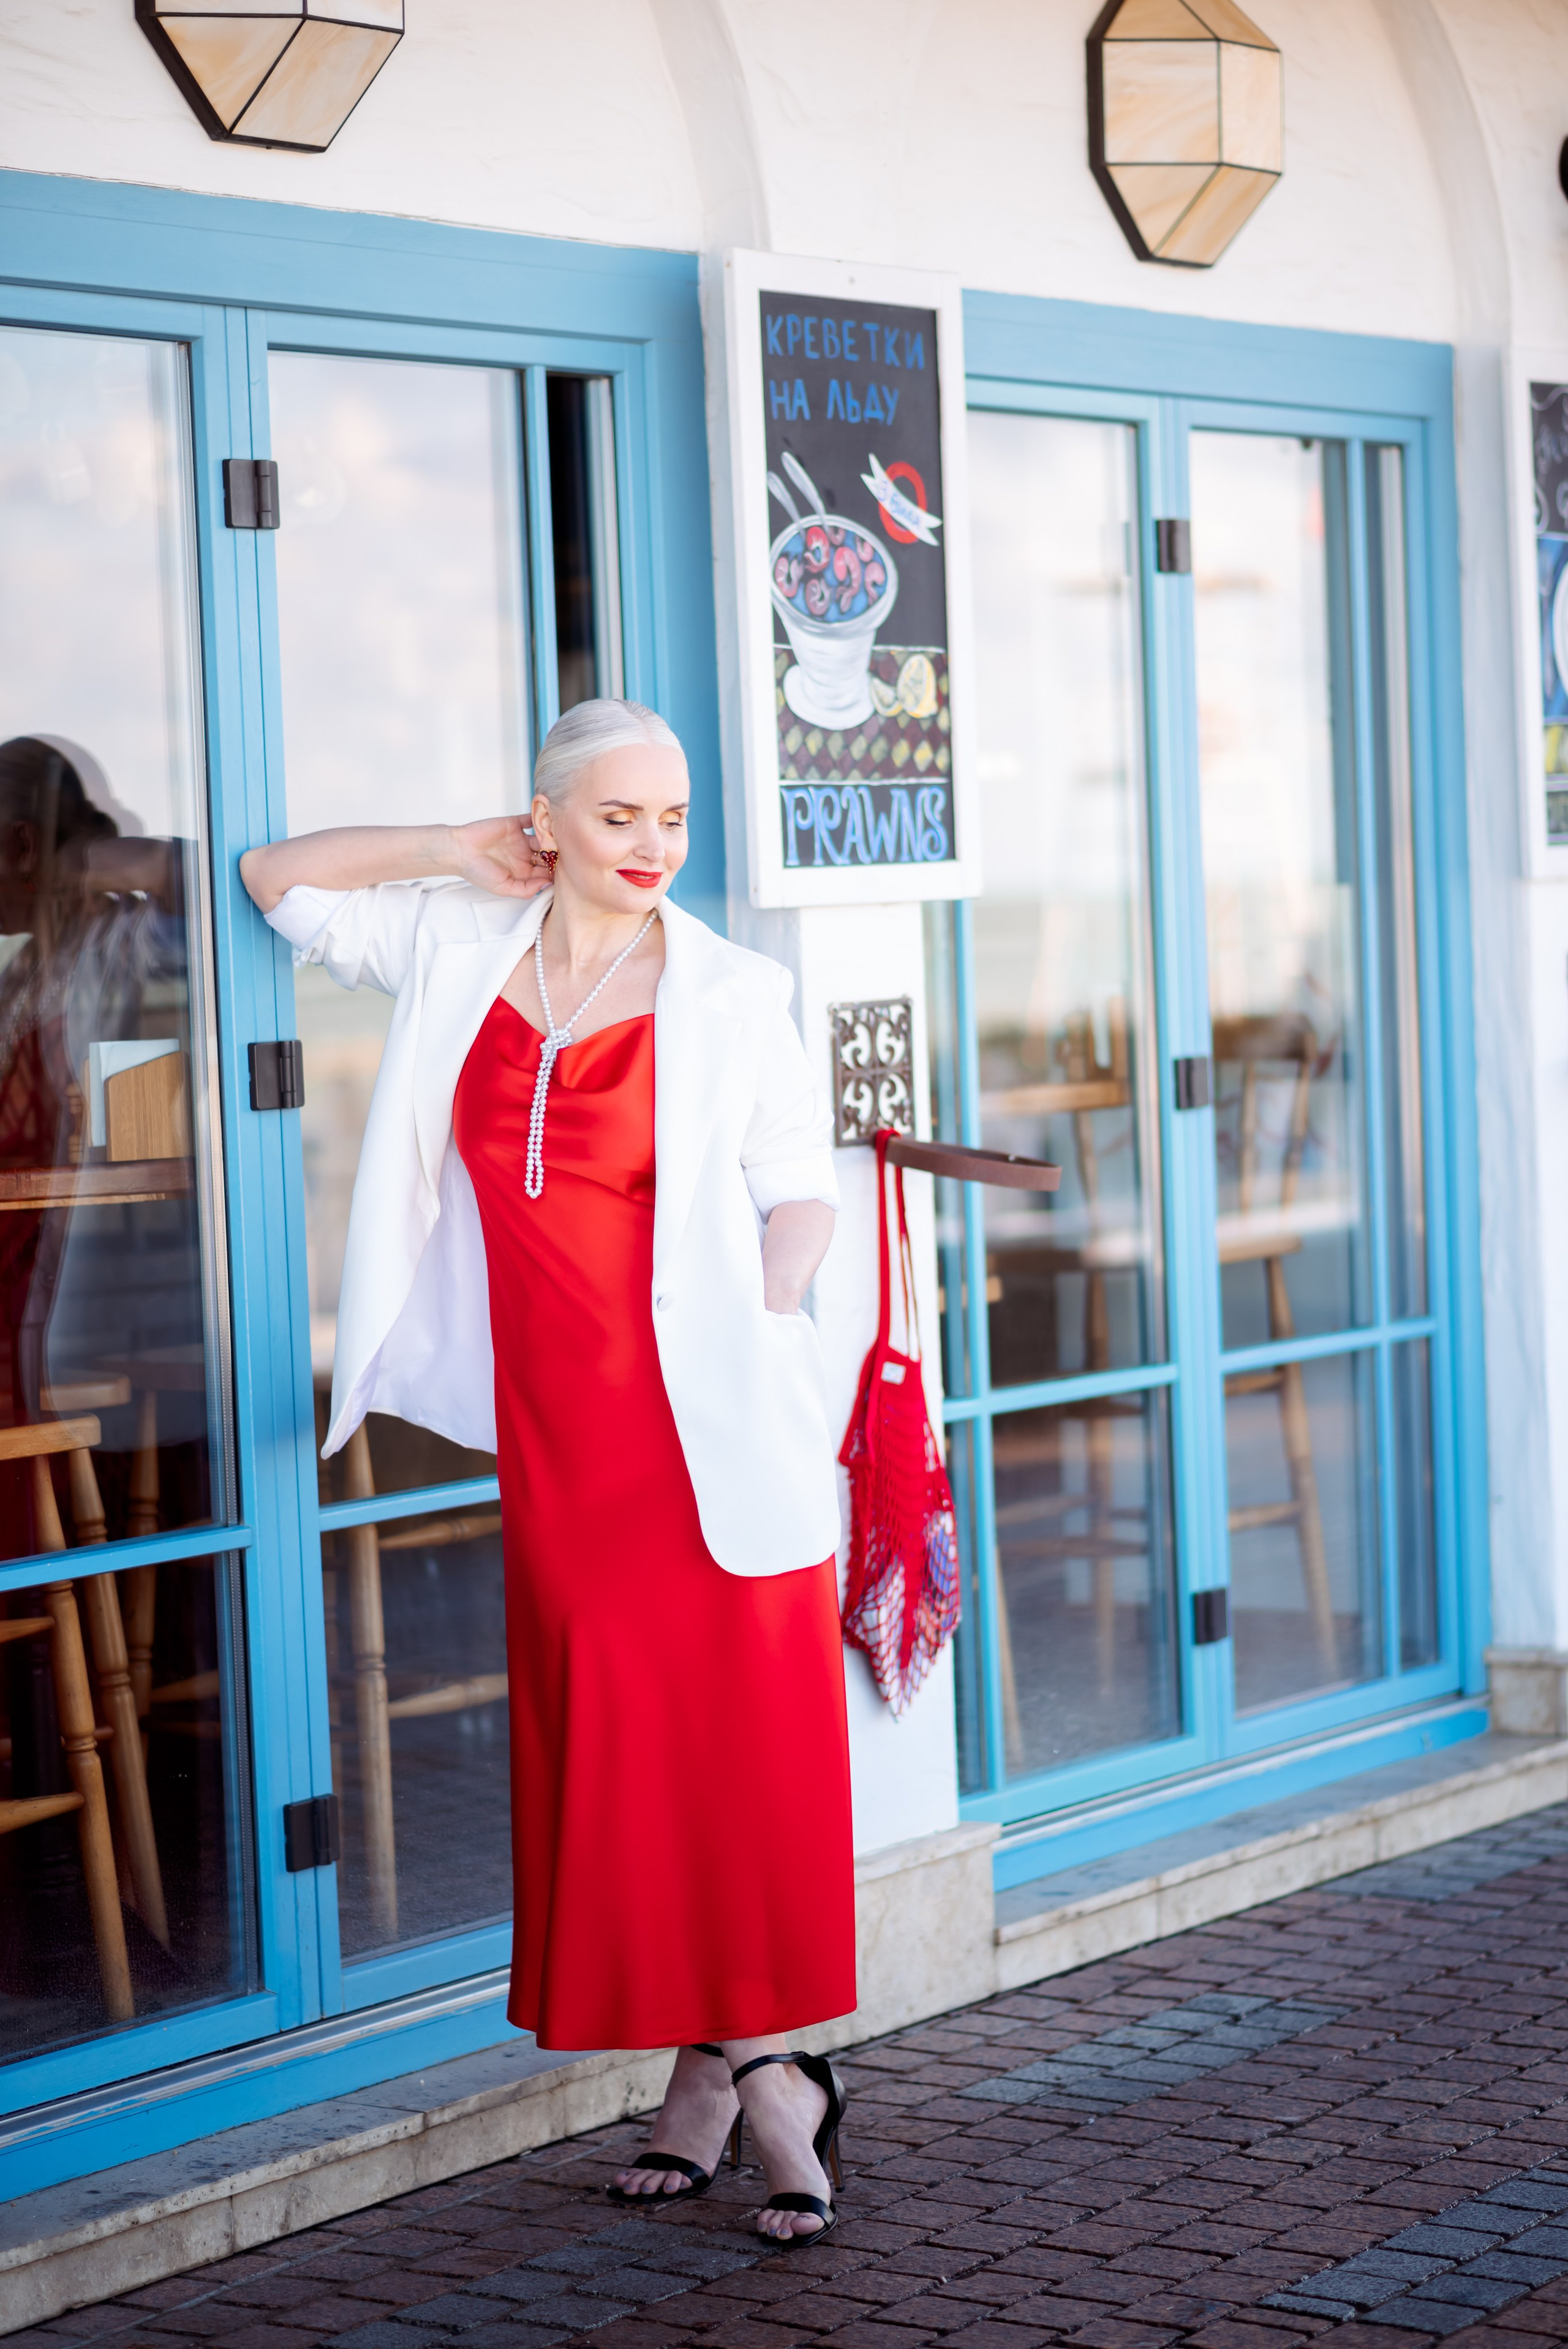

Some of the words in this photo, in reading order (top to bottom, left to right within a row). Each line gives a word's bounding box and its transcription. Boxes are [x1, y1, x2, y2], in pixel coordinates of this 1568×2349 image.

[766, 314, 925, 369] КРЕВЕТКИ
[769, 379, 811, 421] НА
[826, 379, 899, 426] ЛЬДУ
[780, 785, 949, 866] PRAWNS
